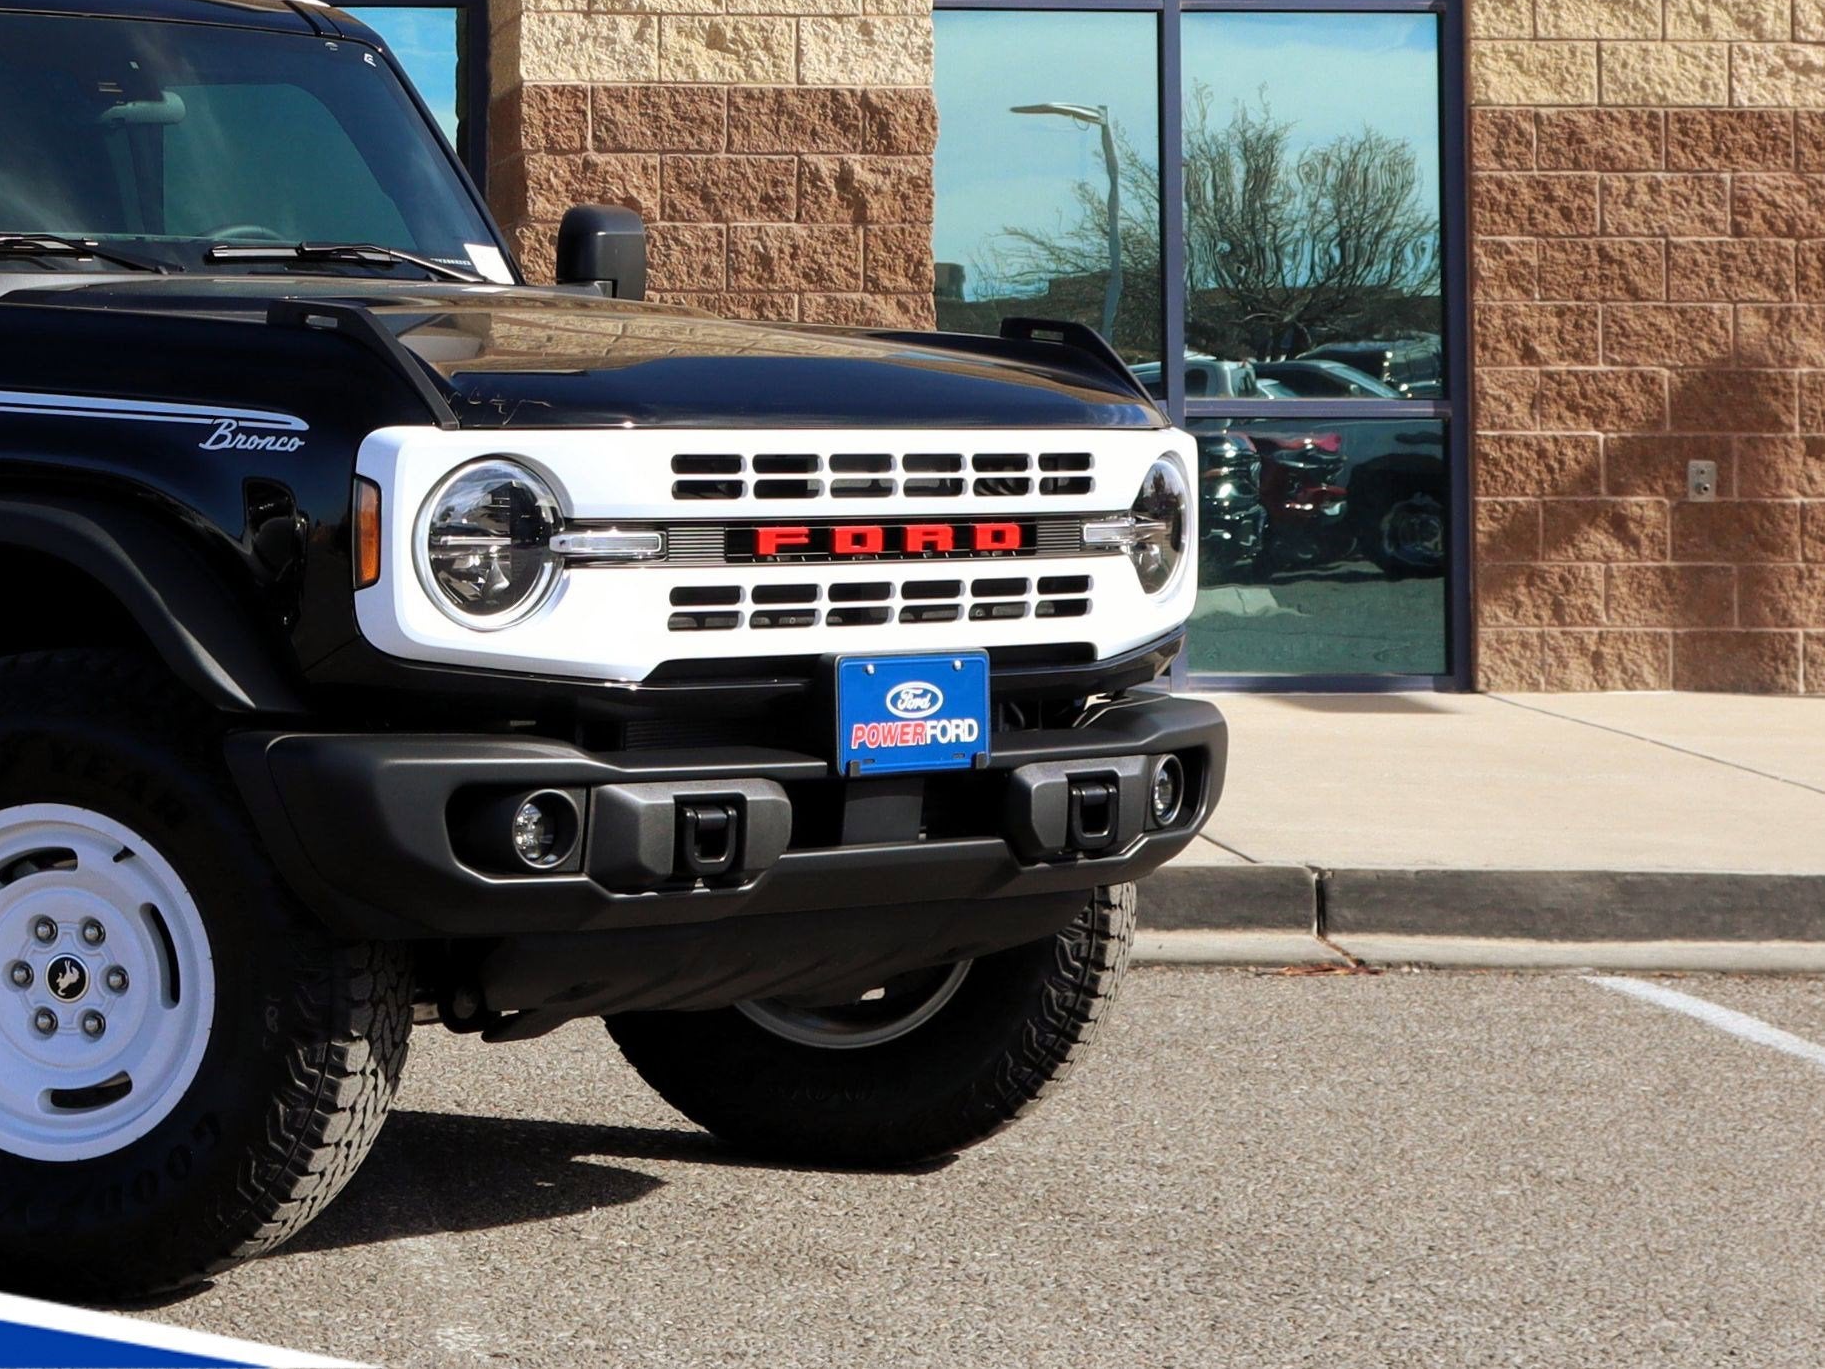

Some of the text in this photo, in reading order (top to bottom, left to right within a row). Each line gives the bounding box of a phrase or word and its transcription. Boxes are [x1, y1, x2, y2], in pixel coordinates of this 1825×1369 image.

[199, 418, 306, 452] Bronco
[754, 522, 1022, 556] FORD
[897, 687, 932, 711] Ford
